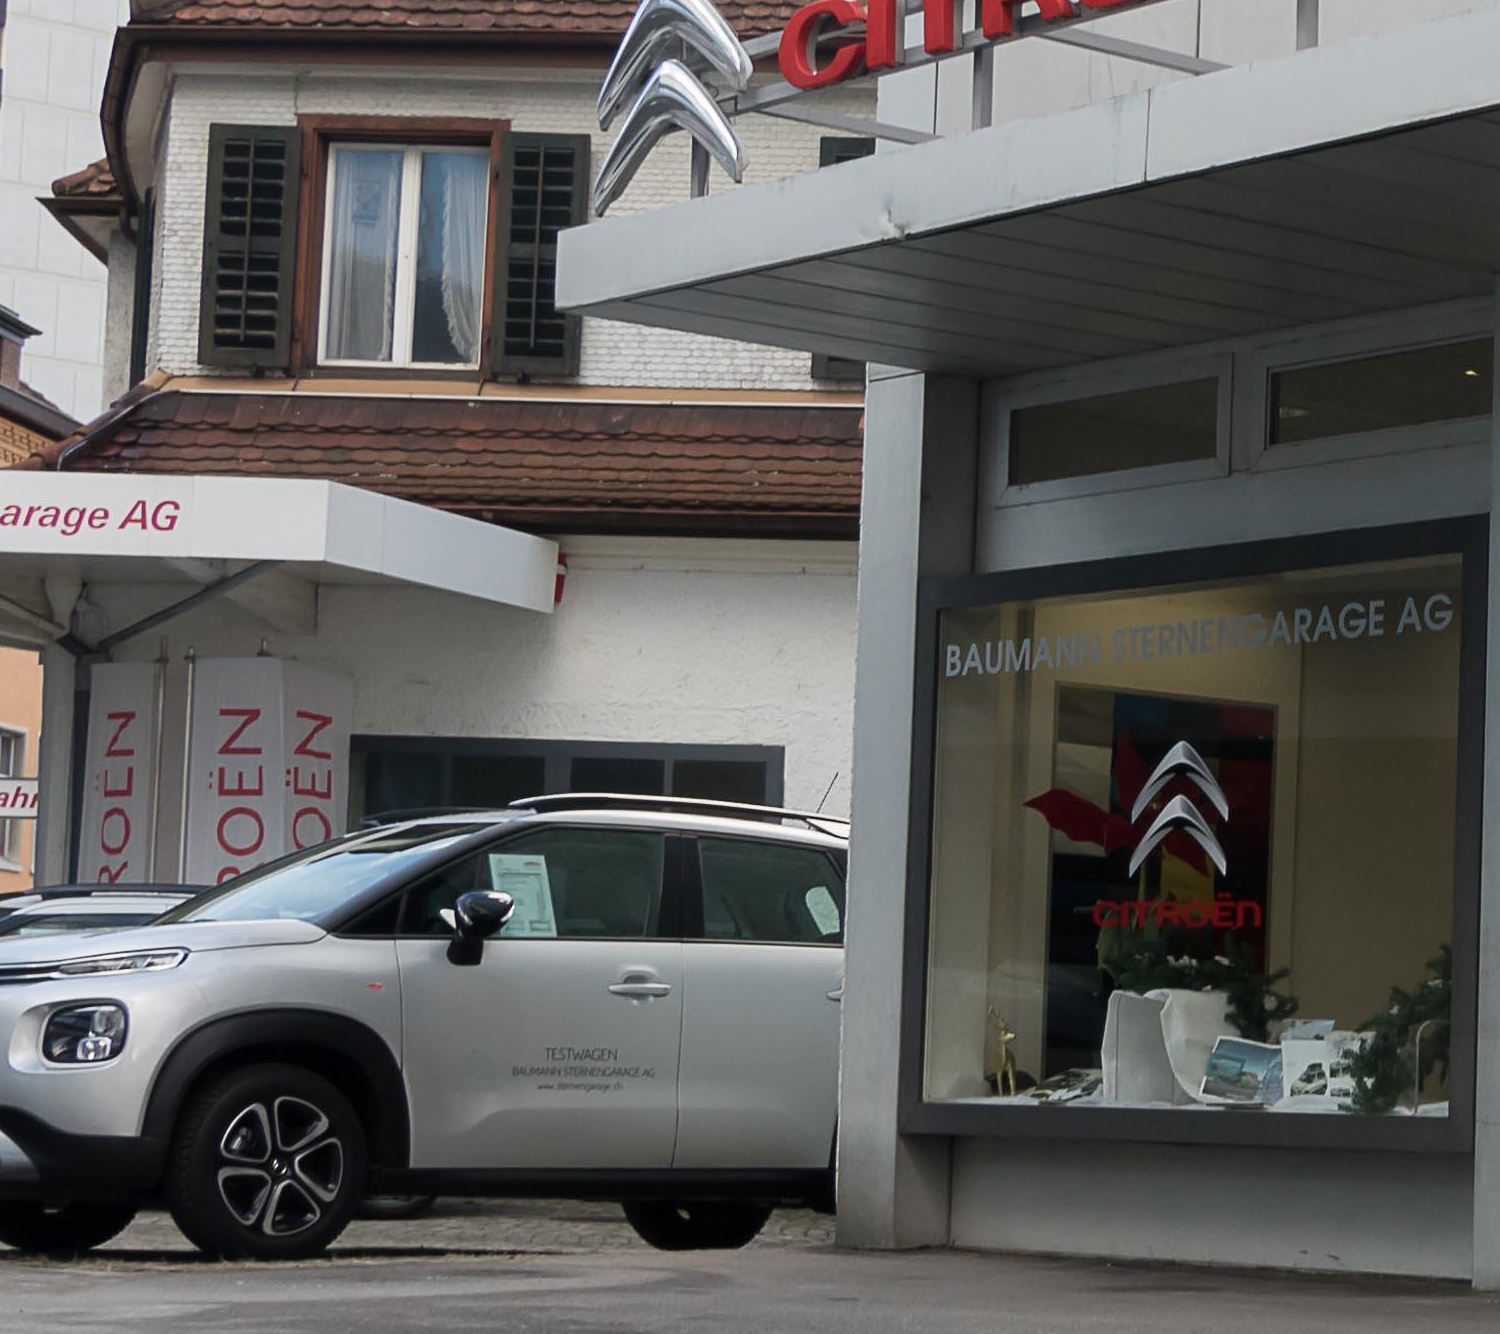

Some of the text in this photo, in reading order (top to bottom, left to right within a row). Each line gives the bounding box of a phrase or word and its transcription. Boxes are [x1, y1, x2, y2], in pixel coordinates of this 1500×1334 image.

[119, 499, 181, 533] AG
[945, 593, 1453, 677] BAUMANN STERNENGARAGE AG
[545, 1047, 618, 1061] TESTWAGEN
